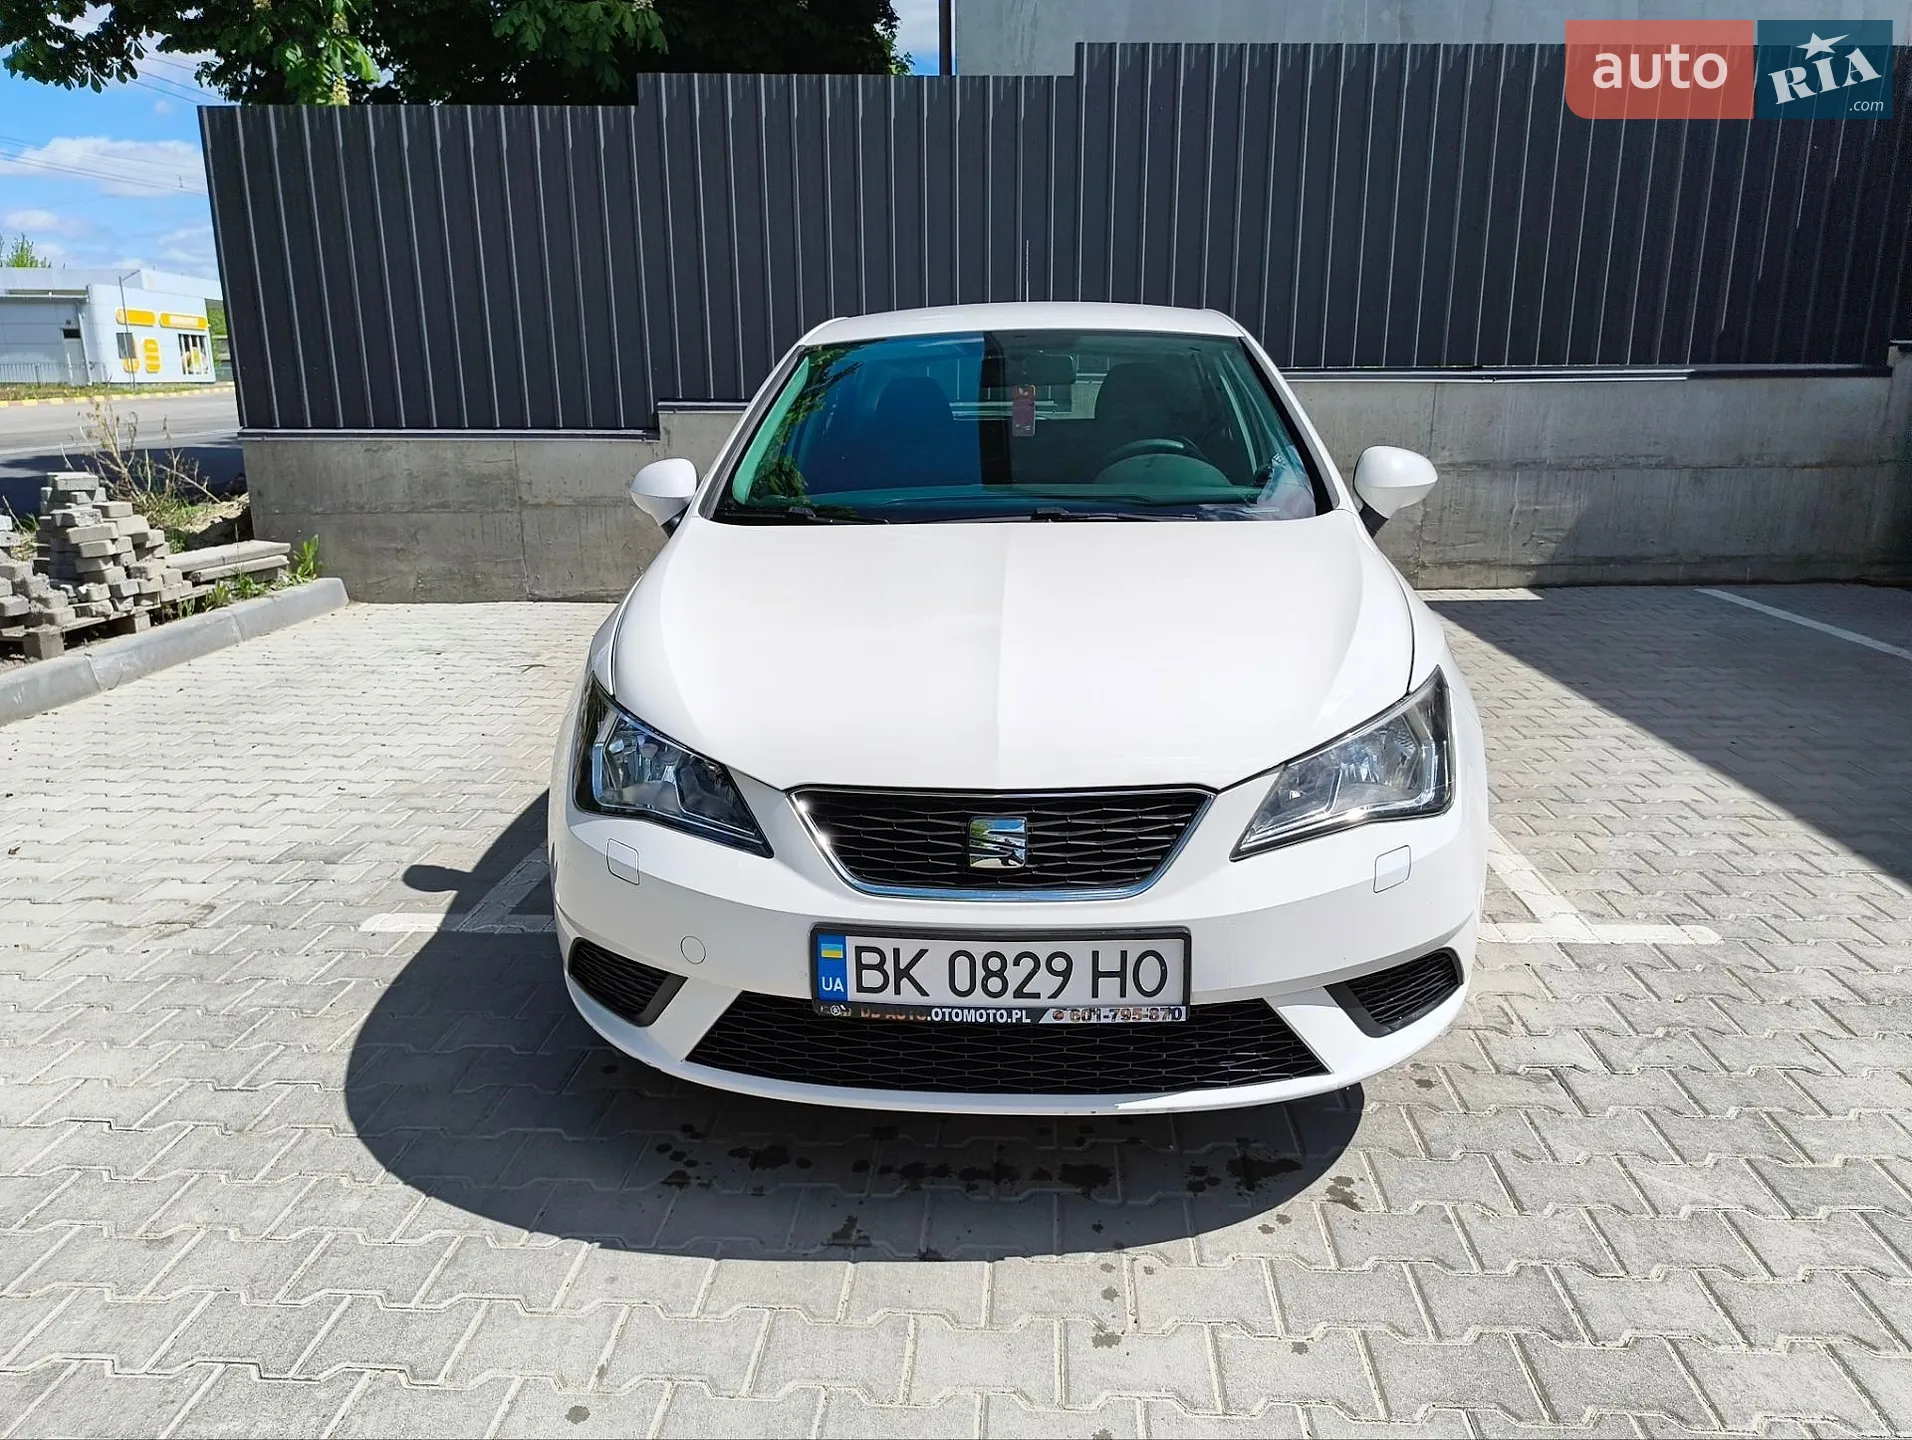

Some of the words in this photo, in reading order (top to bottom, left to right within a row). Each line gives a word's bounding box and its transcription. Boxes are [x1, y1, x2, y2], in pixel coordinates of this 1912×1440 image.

[821, 976, 845, 993] UA
[855, 946, 930, 997] BK
[948, 950, 1073, 999] 0829
[1091, 950, 1168, 998] HO
